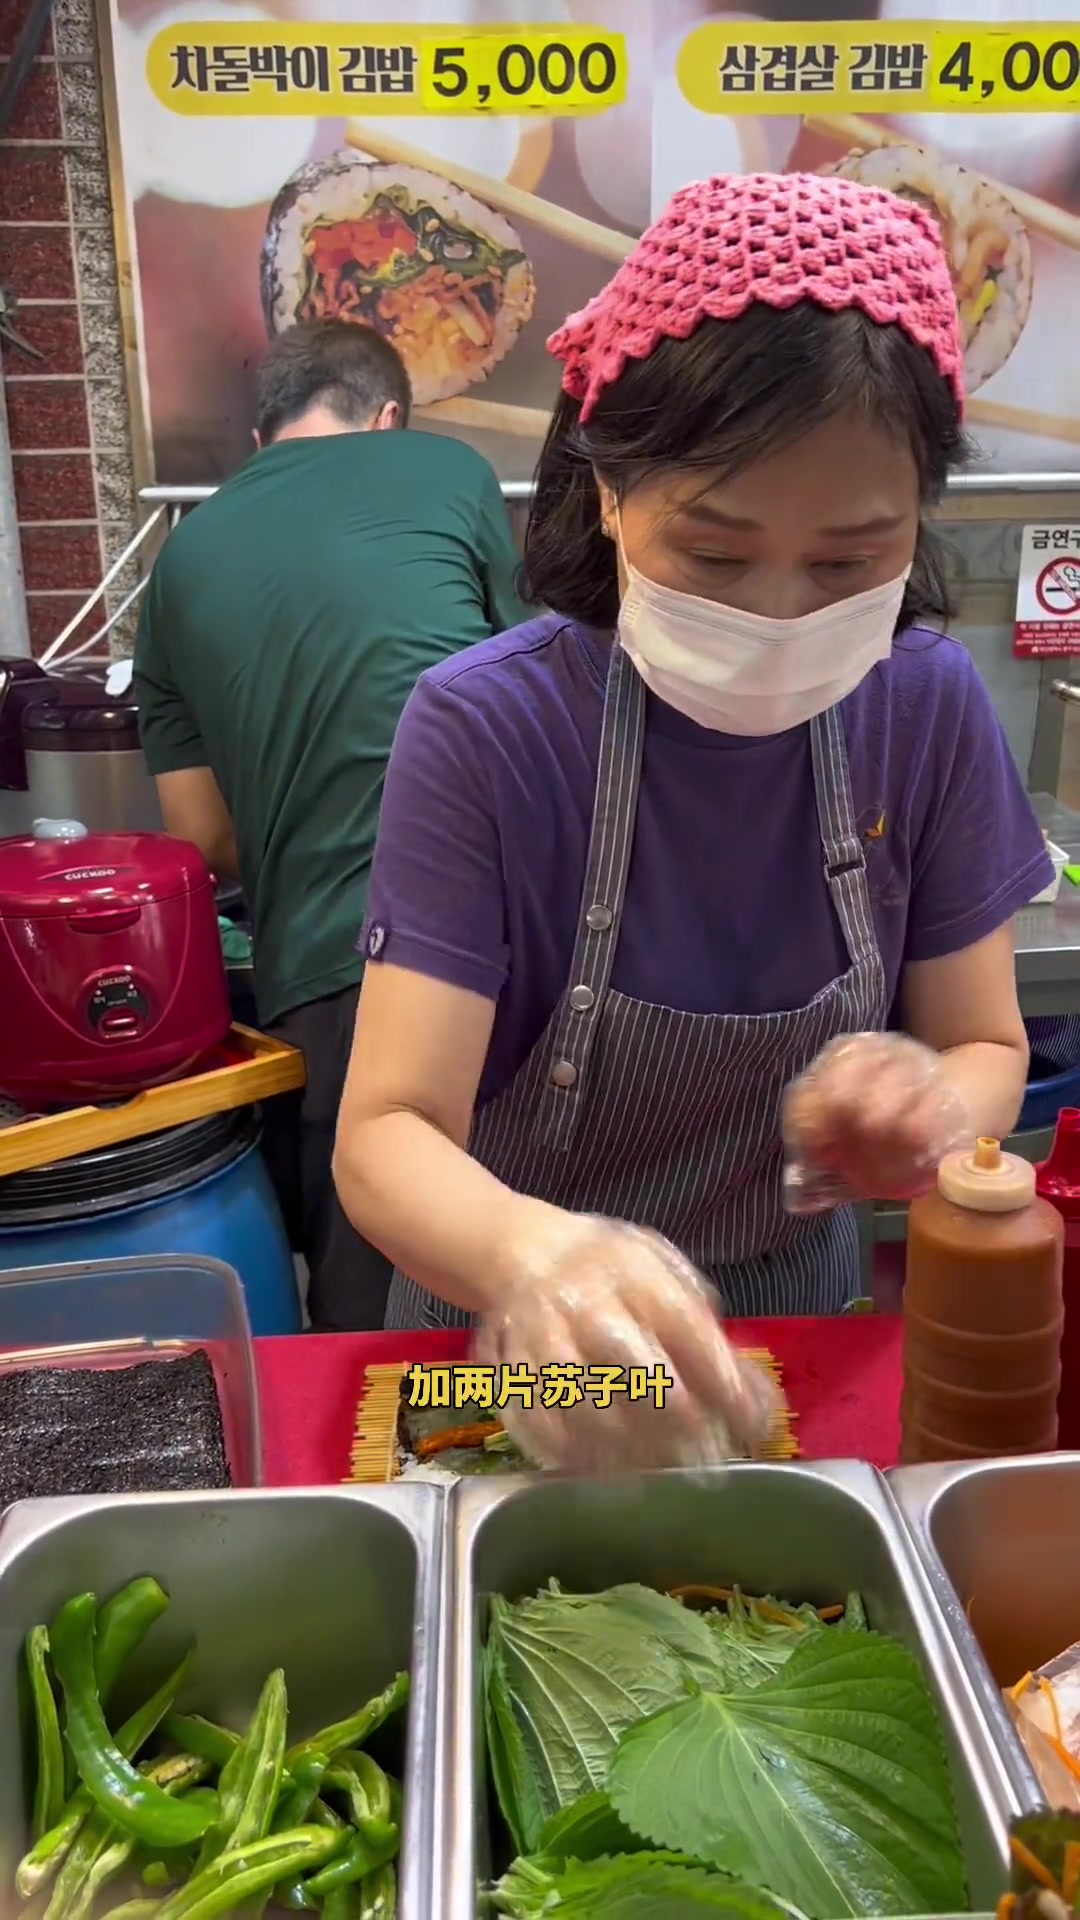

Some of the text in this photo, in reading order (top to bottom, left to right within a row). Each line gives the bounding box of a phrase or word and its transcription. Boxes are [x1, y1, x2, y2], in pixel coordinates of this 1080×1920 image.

[170, 45, 417, 92] 차돌박이 김밥
[432, 42, 617, 102] 5,000
[719, 43, 928, 92] 삼겹살 김밥
[64, 868, 116, 881] CUCKOO
[97, 975, 131, 986] CUCKOO
